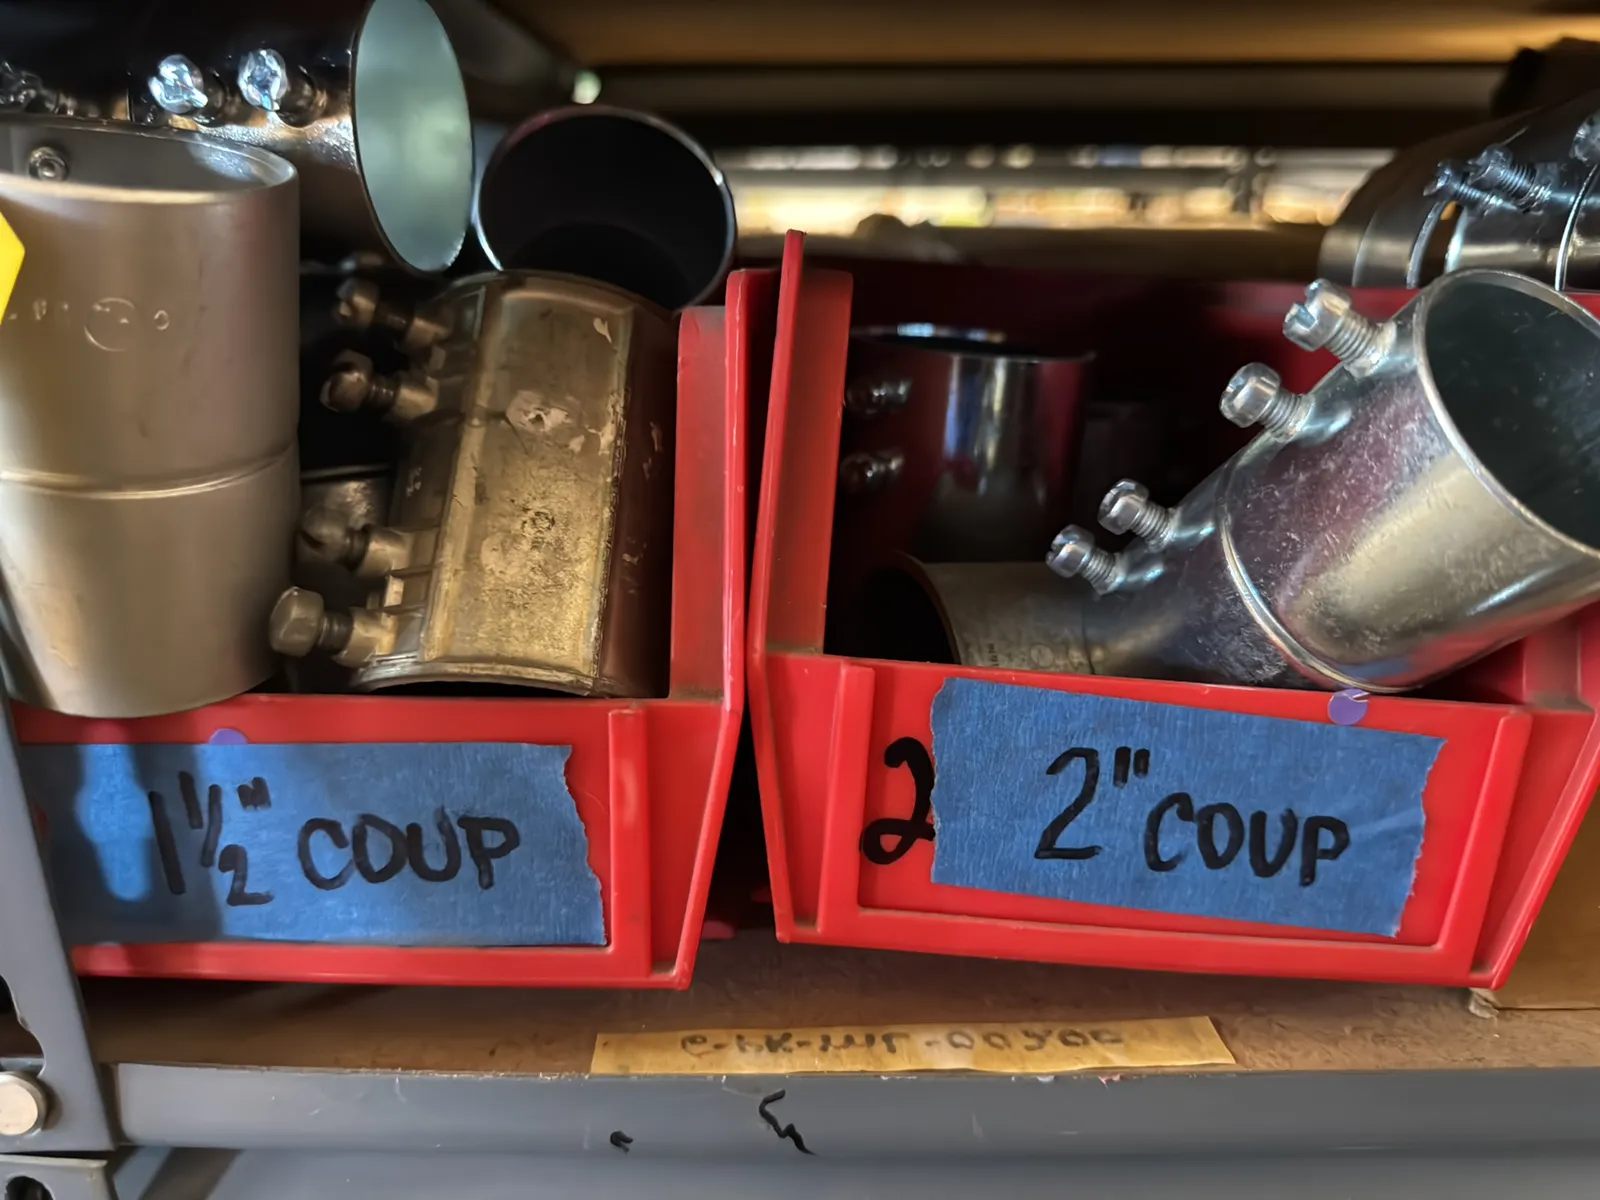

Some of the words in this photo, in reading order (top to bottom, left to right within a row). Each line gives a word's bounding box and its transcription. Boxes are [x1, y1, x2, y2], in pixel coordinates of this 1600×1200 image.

[297, 804, 522, 890] COUP
[859, 736, 936, 865] 2
[1034, 746, 1150, 860] 2"
[1144, 792, 1350, 887] COUP
